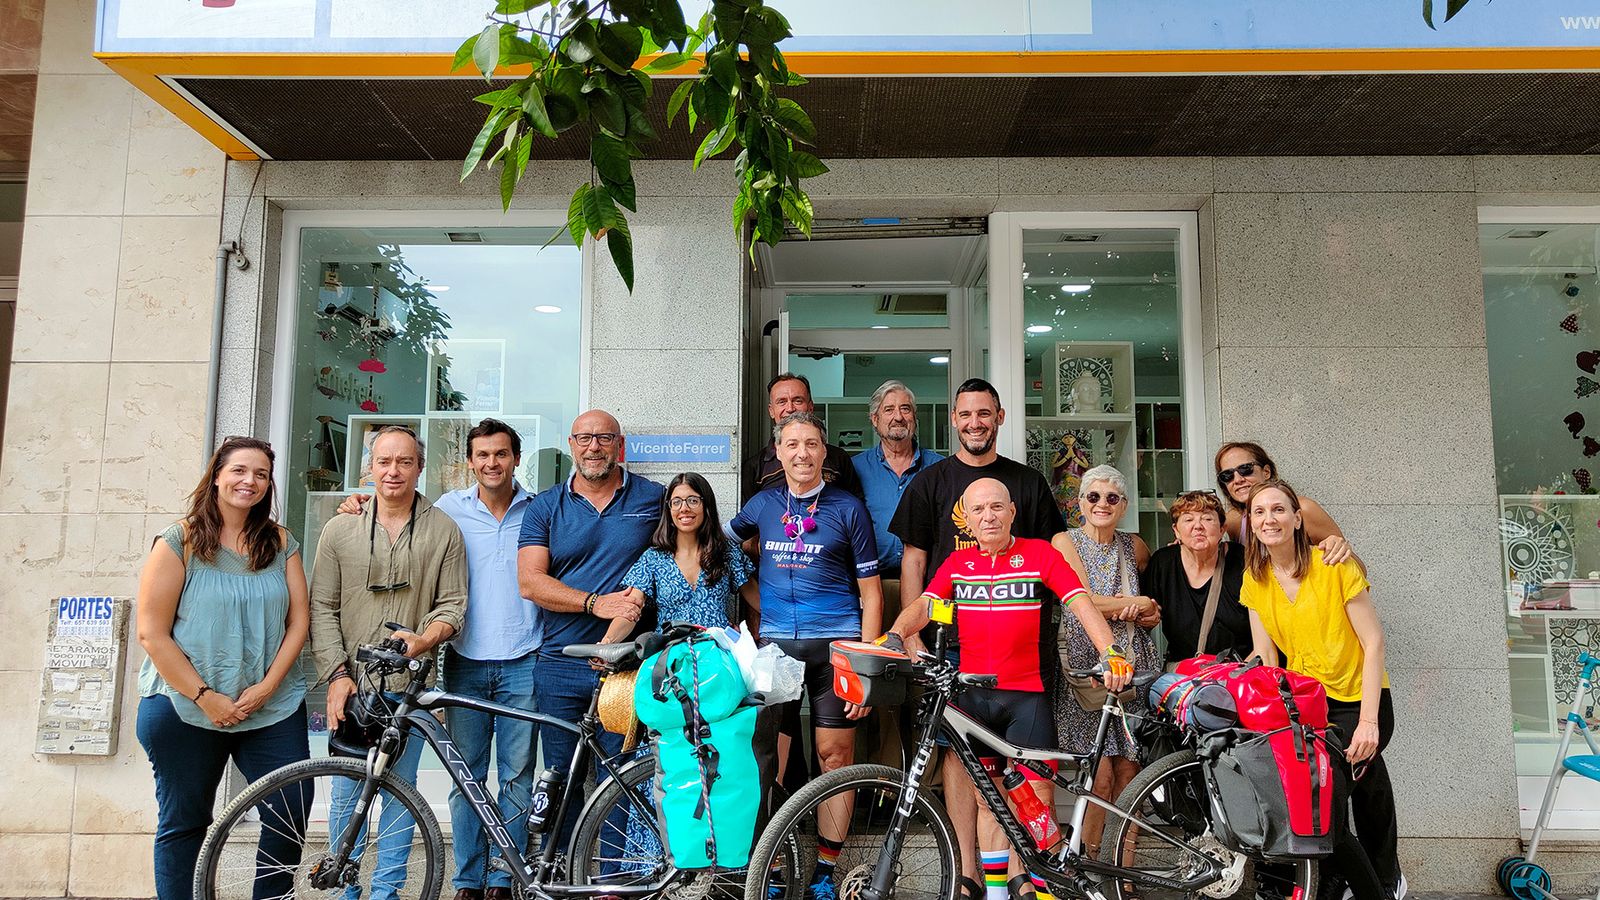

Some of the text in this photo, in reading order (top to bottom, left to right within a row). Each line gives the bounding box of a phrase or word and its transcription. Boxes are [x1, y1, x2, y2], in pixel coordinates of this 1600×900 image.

[630, 442, 726, 454] VicenteFerrer
[765, 541, 824, 554] BIMNT
[771, 551, 791, 562] coffee
[800, 554, 814, 565] shop
[956, 583, 1035, 600] MAGUI
[59, 597, 113, 619] PORTES
[438, 740, 516, 849] KROSS
